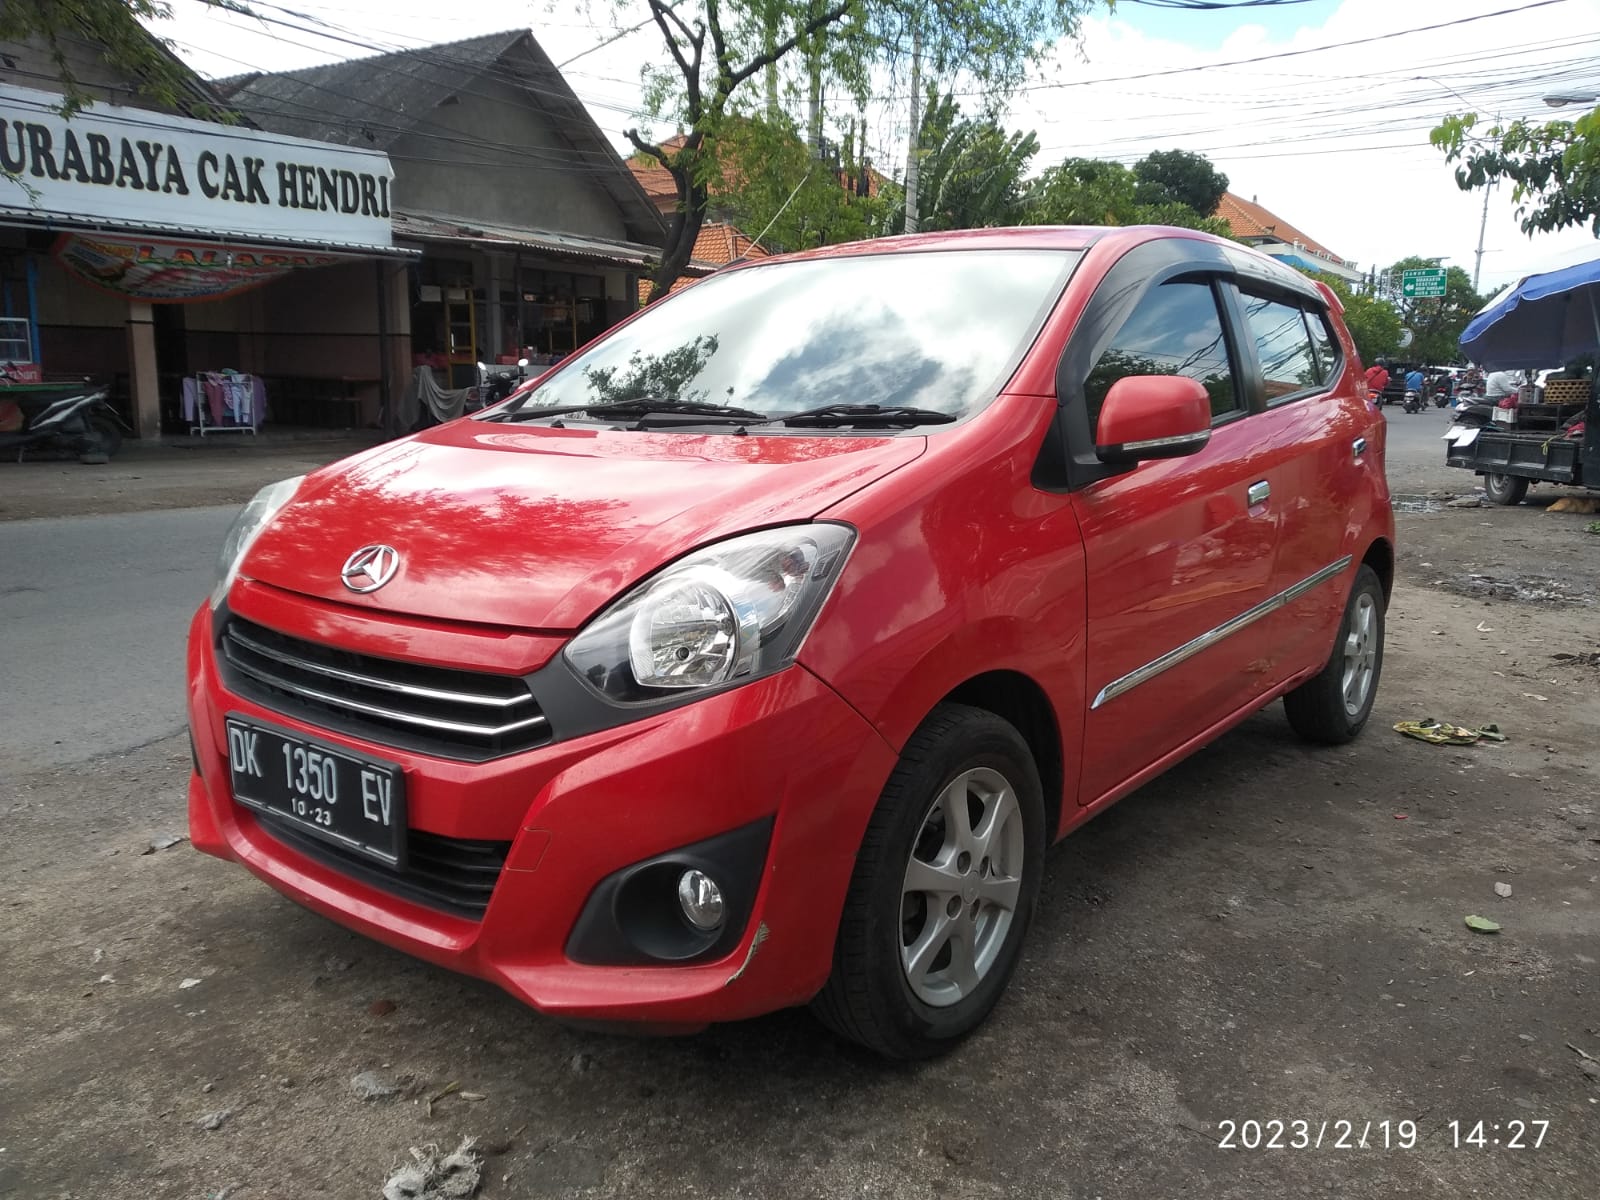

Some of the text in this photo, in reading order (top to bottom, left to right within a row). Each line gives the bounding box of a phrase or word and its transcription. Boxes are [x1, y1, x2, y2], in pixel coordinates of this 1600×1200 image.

[197, 150, 270, 204] CAK
[276, 161, 391, 218] HENDRI
[229, 727, 391, 826] DK 1350 EV
